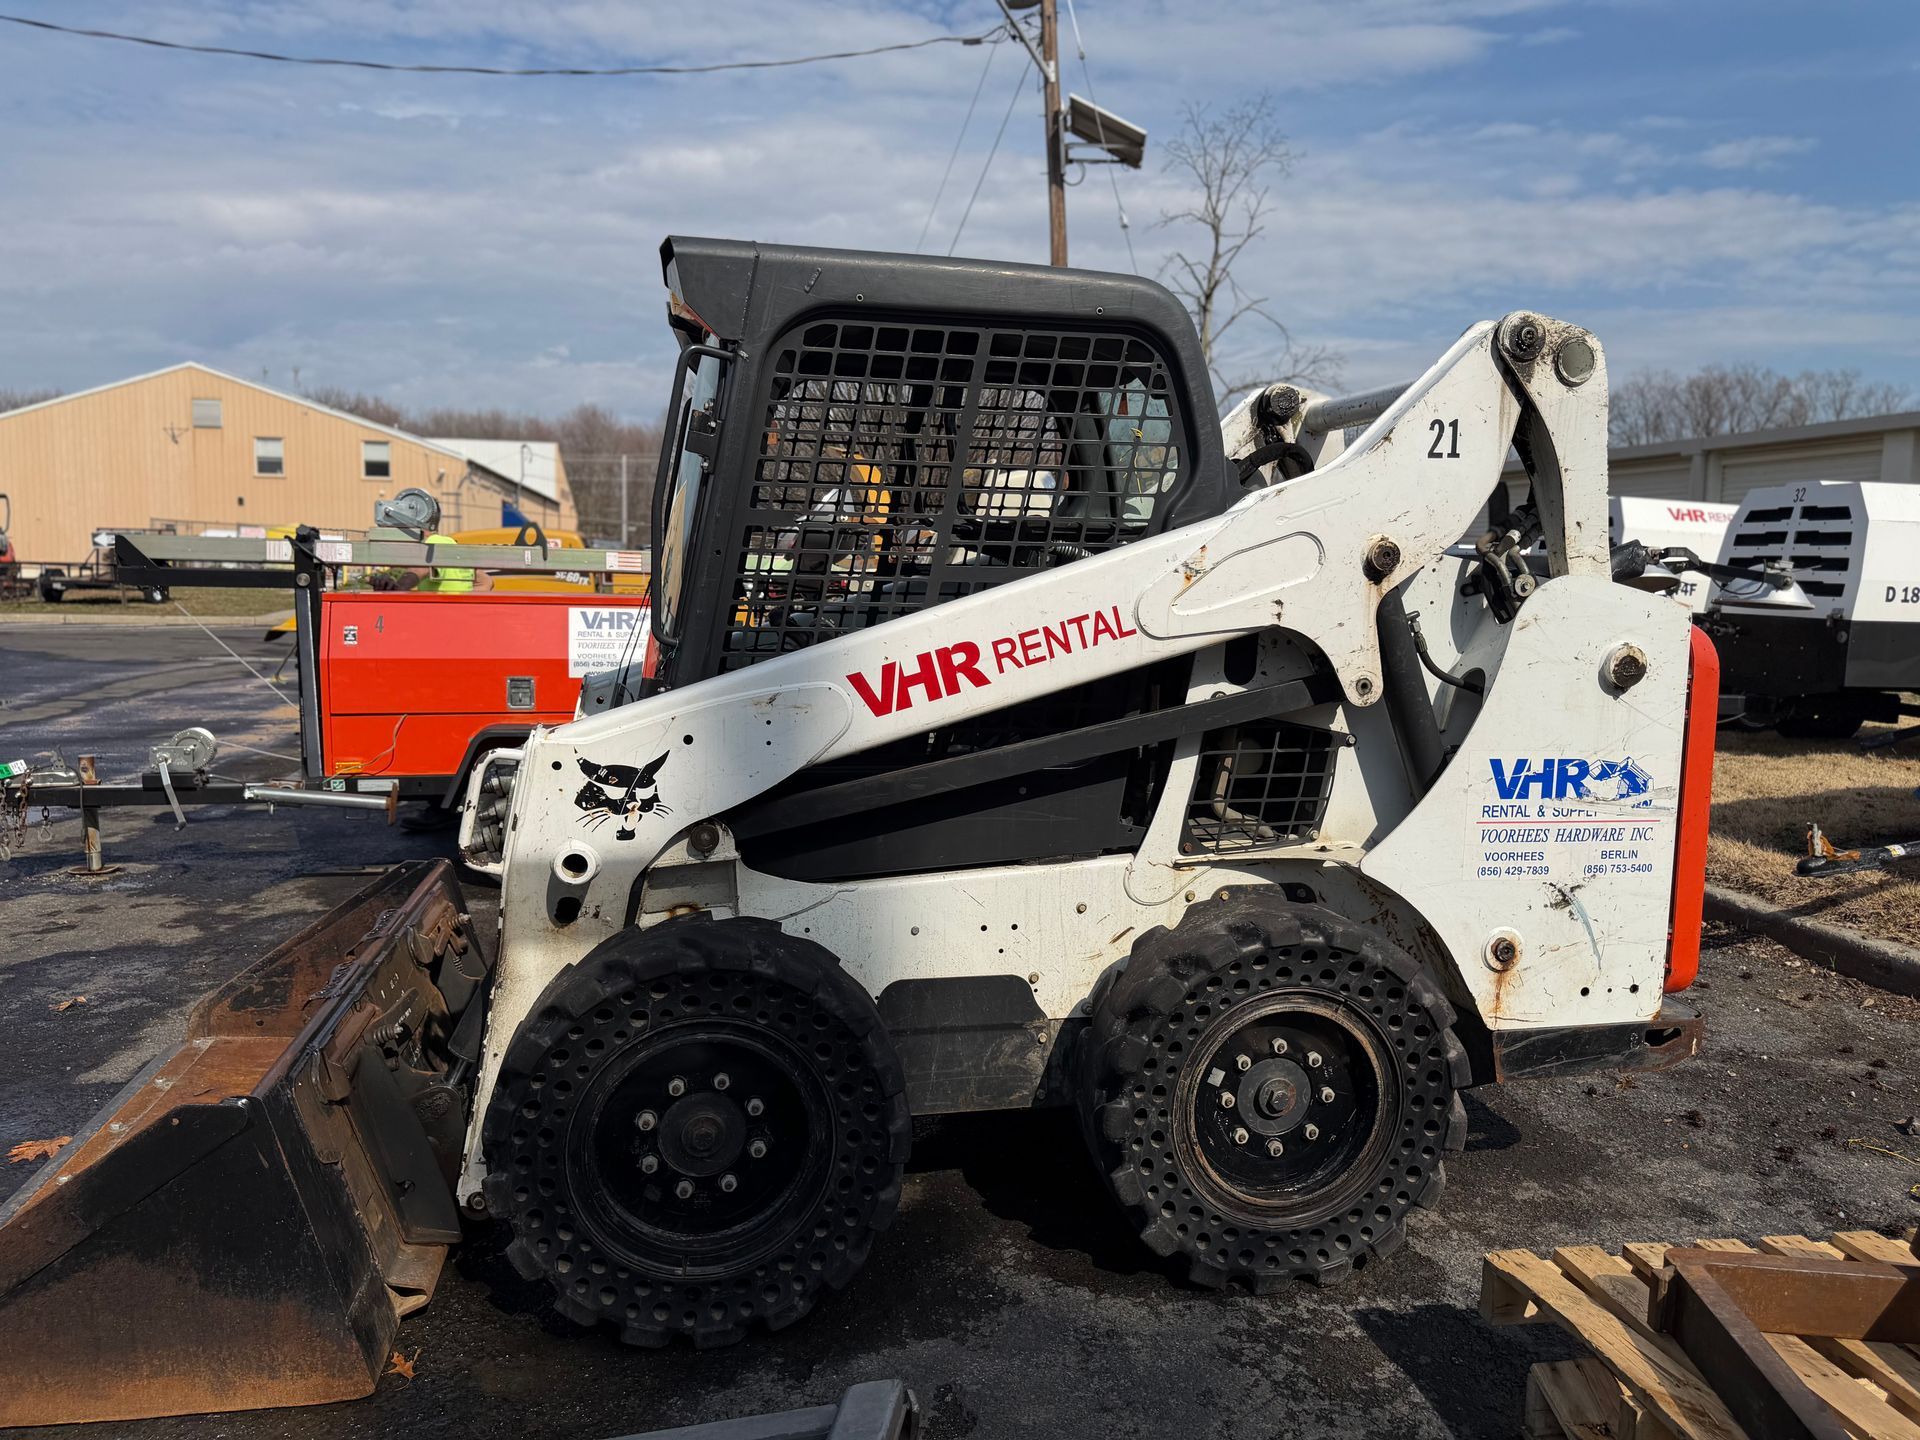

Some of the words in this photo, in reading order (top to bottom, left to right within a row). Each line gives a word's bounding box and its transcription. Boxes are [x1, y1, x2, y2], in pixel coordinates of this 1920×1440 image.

[1428, 418, 1461, 458] 21
[1793, 487, 1806, 502] 32
[1667, 507, 1707, 522] VHR
[1885, 586, 1896, 602] D
[375, 615, 384, 633] 4
[580, 611, 635, 630] VHR
[577, 642, 616, 650] VOORHEES
[845, 640, 992, 718] VHR
[991, 605, 1137, 674] RENTAL
[1489, 758, 1590, 800] VHR
[1482, 804, 1530, 818] RENTAL
[1537, 805, 1546, 817] &
[1480, 828, 1550, 844] VOORHEES
[1554, 827, 1625, 843] HARDWARE
[1630, 826, 1654, 841] INC.
[1484, 851, 1545, 862] VOORHEES
[1600, 849, 1639, 860] BERLIN
[1477, 866, 1502, 877] (856)
[1504, 865, 1550, 876] 429-7839
[1583, 864, 1608, 875] (856)
[1610, 863, 1653, 873] 753-5400
